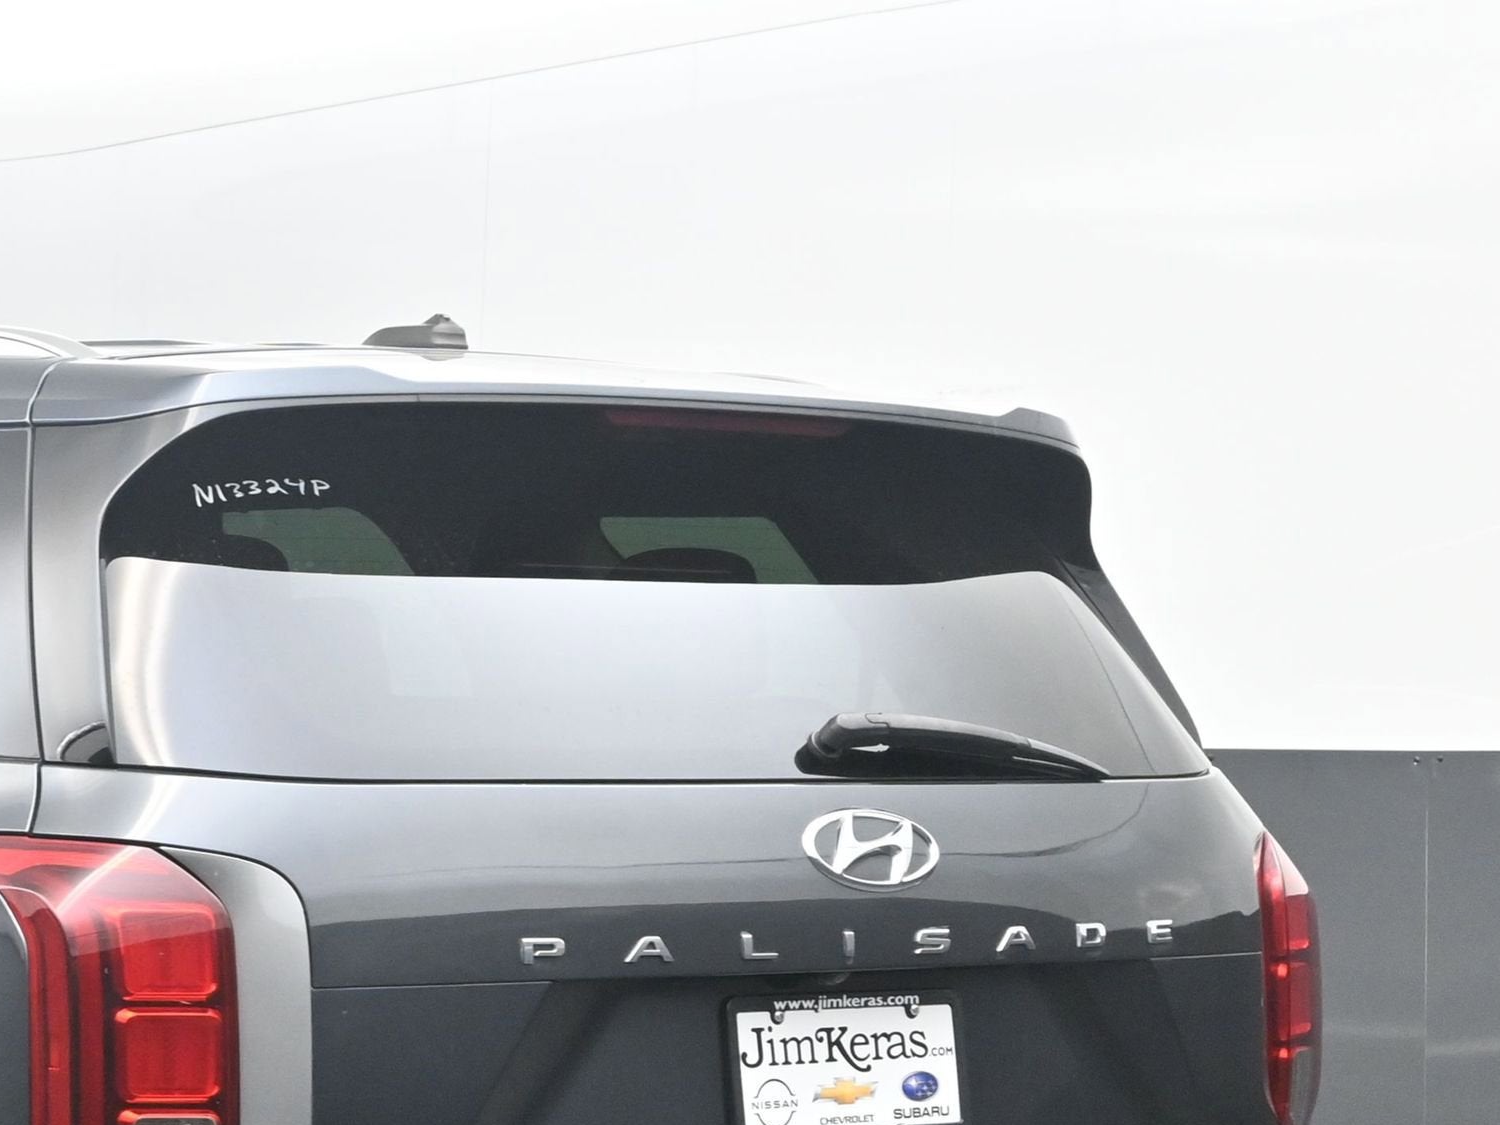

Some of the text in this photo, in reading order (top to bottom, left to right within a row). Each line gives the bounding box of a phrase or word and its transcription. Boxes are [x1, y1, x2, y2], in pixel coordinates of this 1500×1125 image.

[520, 919, 1173, 965] PALISADE
[773, 995, 920, 1010] www.jimkeras.com
[751, 1098, 799, 1110] NISSAN
[820, 1114, 875, 1125] CHEVROLET
[893, 1105, 950, 1120] SUBARU
